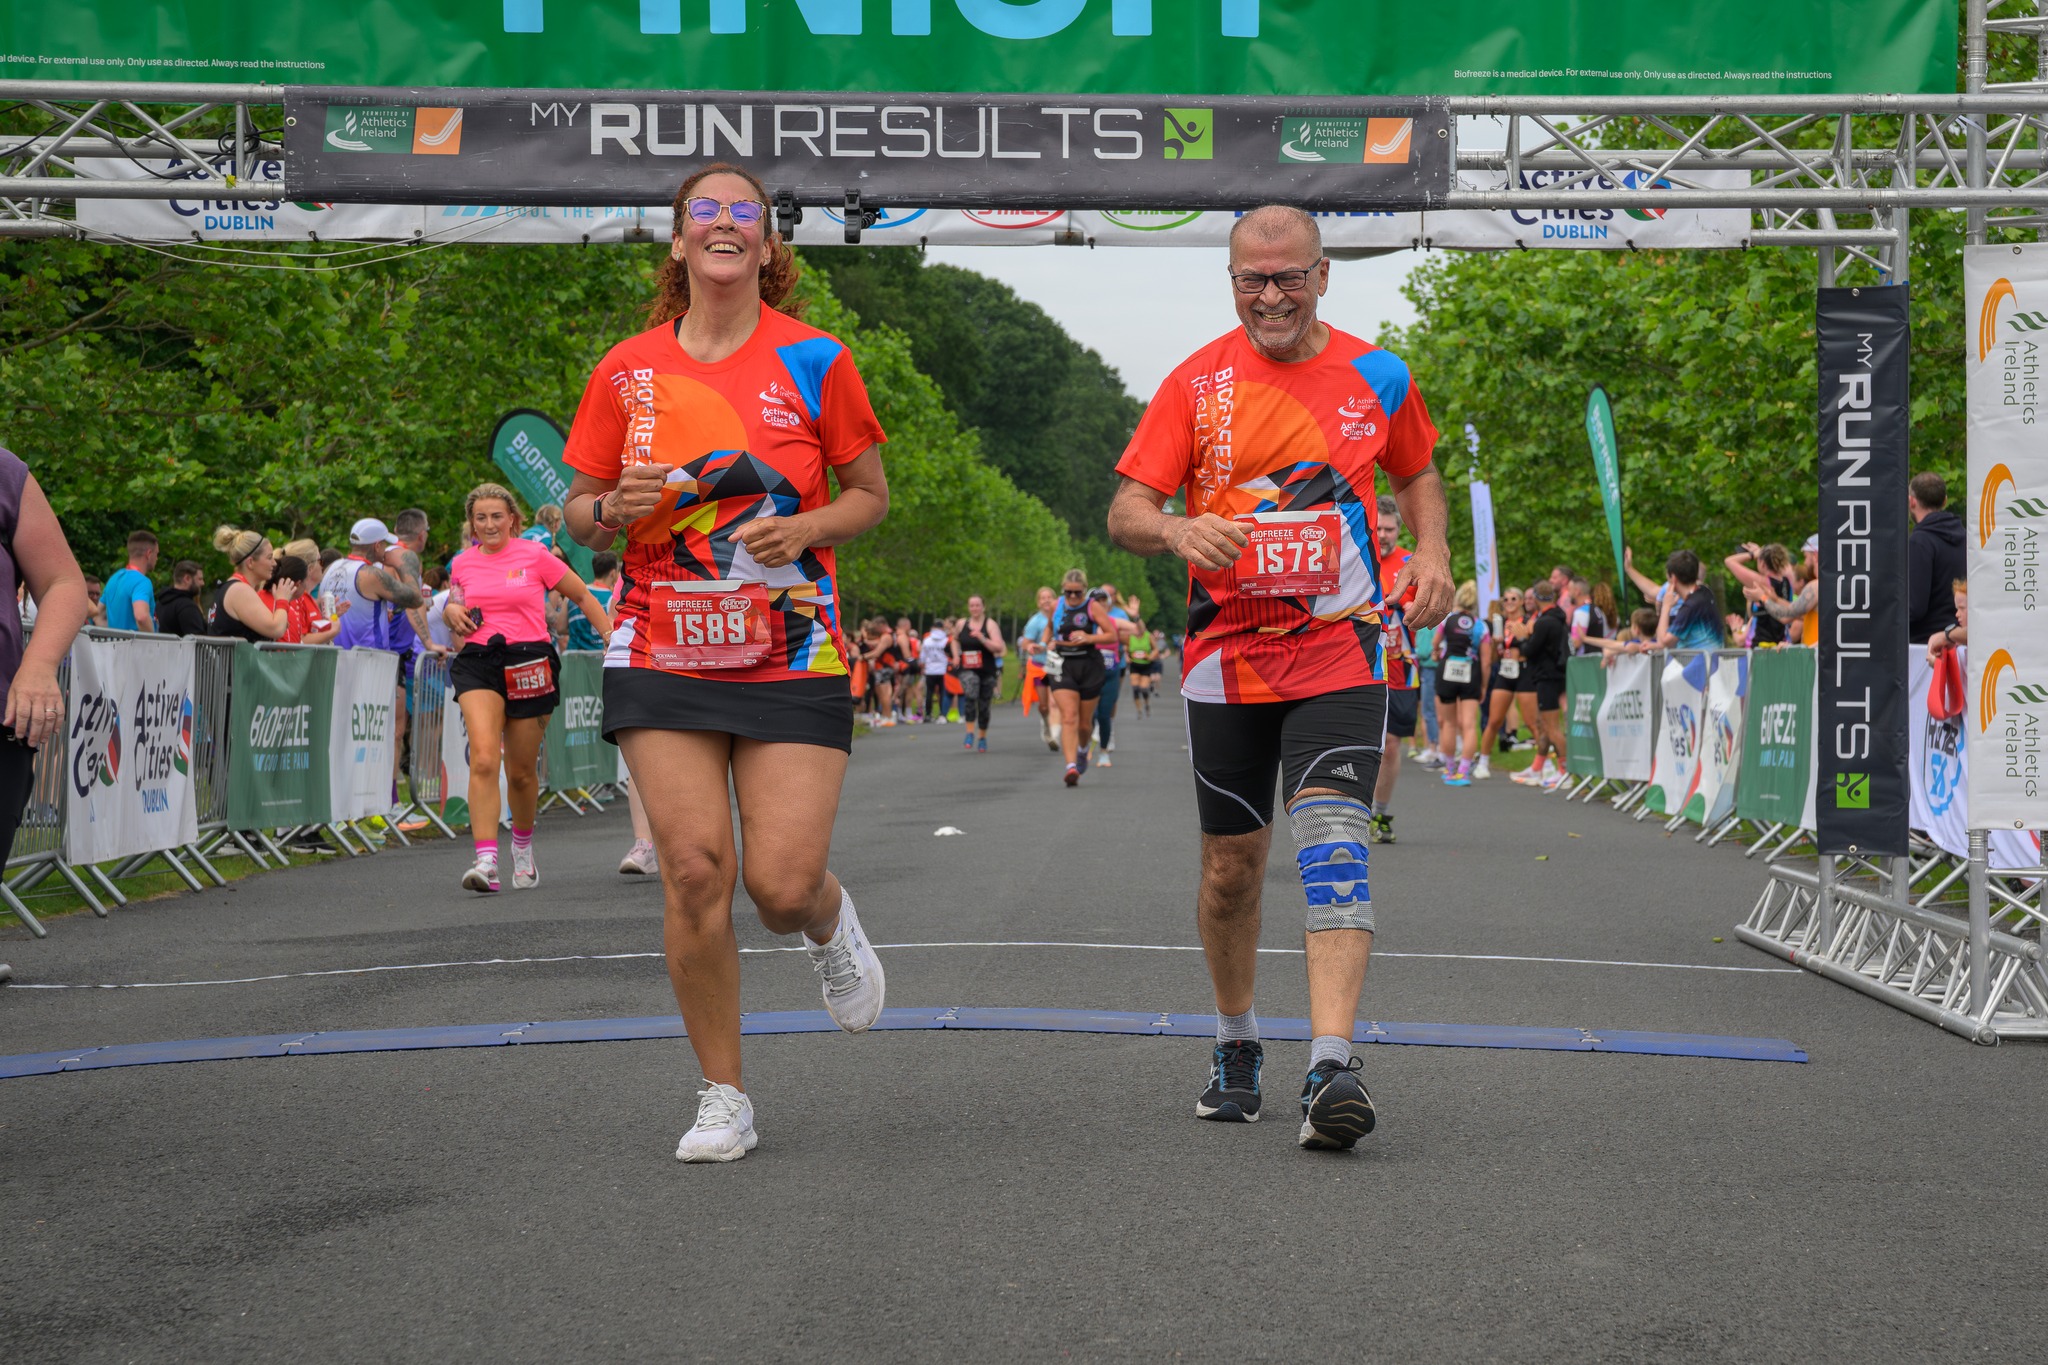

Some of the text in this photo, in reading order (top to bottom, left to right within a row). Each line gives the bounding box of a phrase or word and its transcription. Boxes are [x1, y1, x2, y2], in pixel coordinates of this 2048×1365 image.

[7, 54, 37, 63] device.
[38, 56, 52, 64] For
[54, 56, 88, 65] external
[106, 57, 126, 67] only.
[127, 57, 146, 67] Only
[175, 58, 210, 67] directed.
[211, 59, 238, 69] Always
[240, 60, 259, 68] read
[260, 60, 274, 68] the
[276, 60, 325, 69] instructions
[1454, 70, 1492, 78] Biofreeze
[1506, 70, 1537, 78] medical
[1538, 69, 1564, 78] device.
[1566, 68, 1578, 77] For
[1580, 69, 1608, 77] external
[1624, 70, 1642, 80] only.
[1643, 70, 1661, 80] Only
[1688, 71, 1723, 80] directed.
[1724, 71, 1751, 81] Always
[1786, 71, 1832, 79] instructions
[360, 117, 407, 128] Athletics
[360, 128, 397, 138] Ireland
[532, 102, 1143, 160] MY RUN RESULTS
[1314, 128, 1359, 138] Athletics
[1314, 138, 1349, 148] Ireland
[205, 216, 274, 230] DUBLIN
[1543, 225, 1608, 239] DUBLIN
[2004, 342, 2020, 406] Ireland
[2023, 340, 2040, 424] Athletics
[762, 406, 788, 416] Active
[764, 414, 788, 424] Cities
[1340, 421, 1365, 430] Active
[1256, 541, 1323, 574] 1572
[1836, 333, 1873, 760] MY RUN RESULTS
[2004, 528, 2020, 592] Ireland
[2023, 528, 2040, 611] Athletics
[673, 612, 746, 646] 1589
[134, 679, 179, 734] Active
[2006, 714, 2022, 778] Ireland
[2024, 713, 2040, 798] Athletics
[134, 732, 172, 792] Cities
[1331, 768, 1359, 782] adidas
[142, 788, 170, 813] DUBLIN
